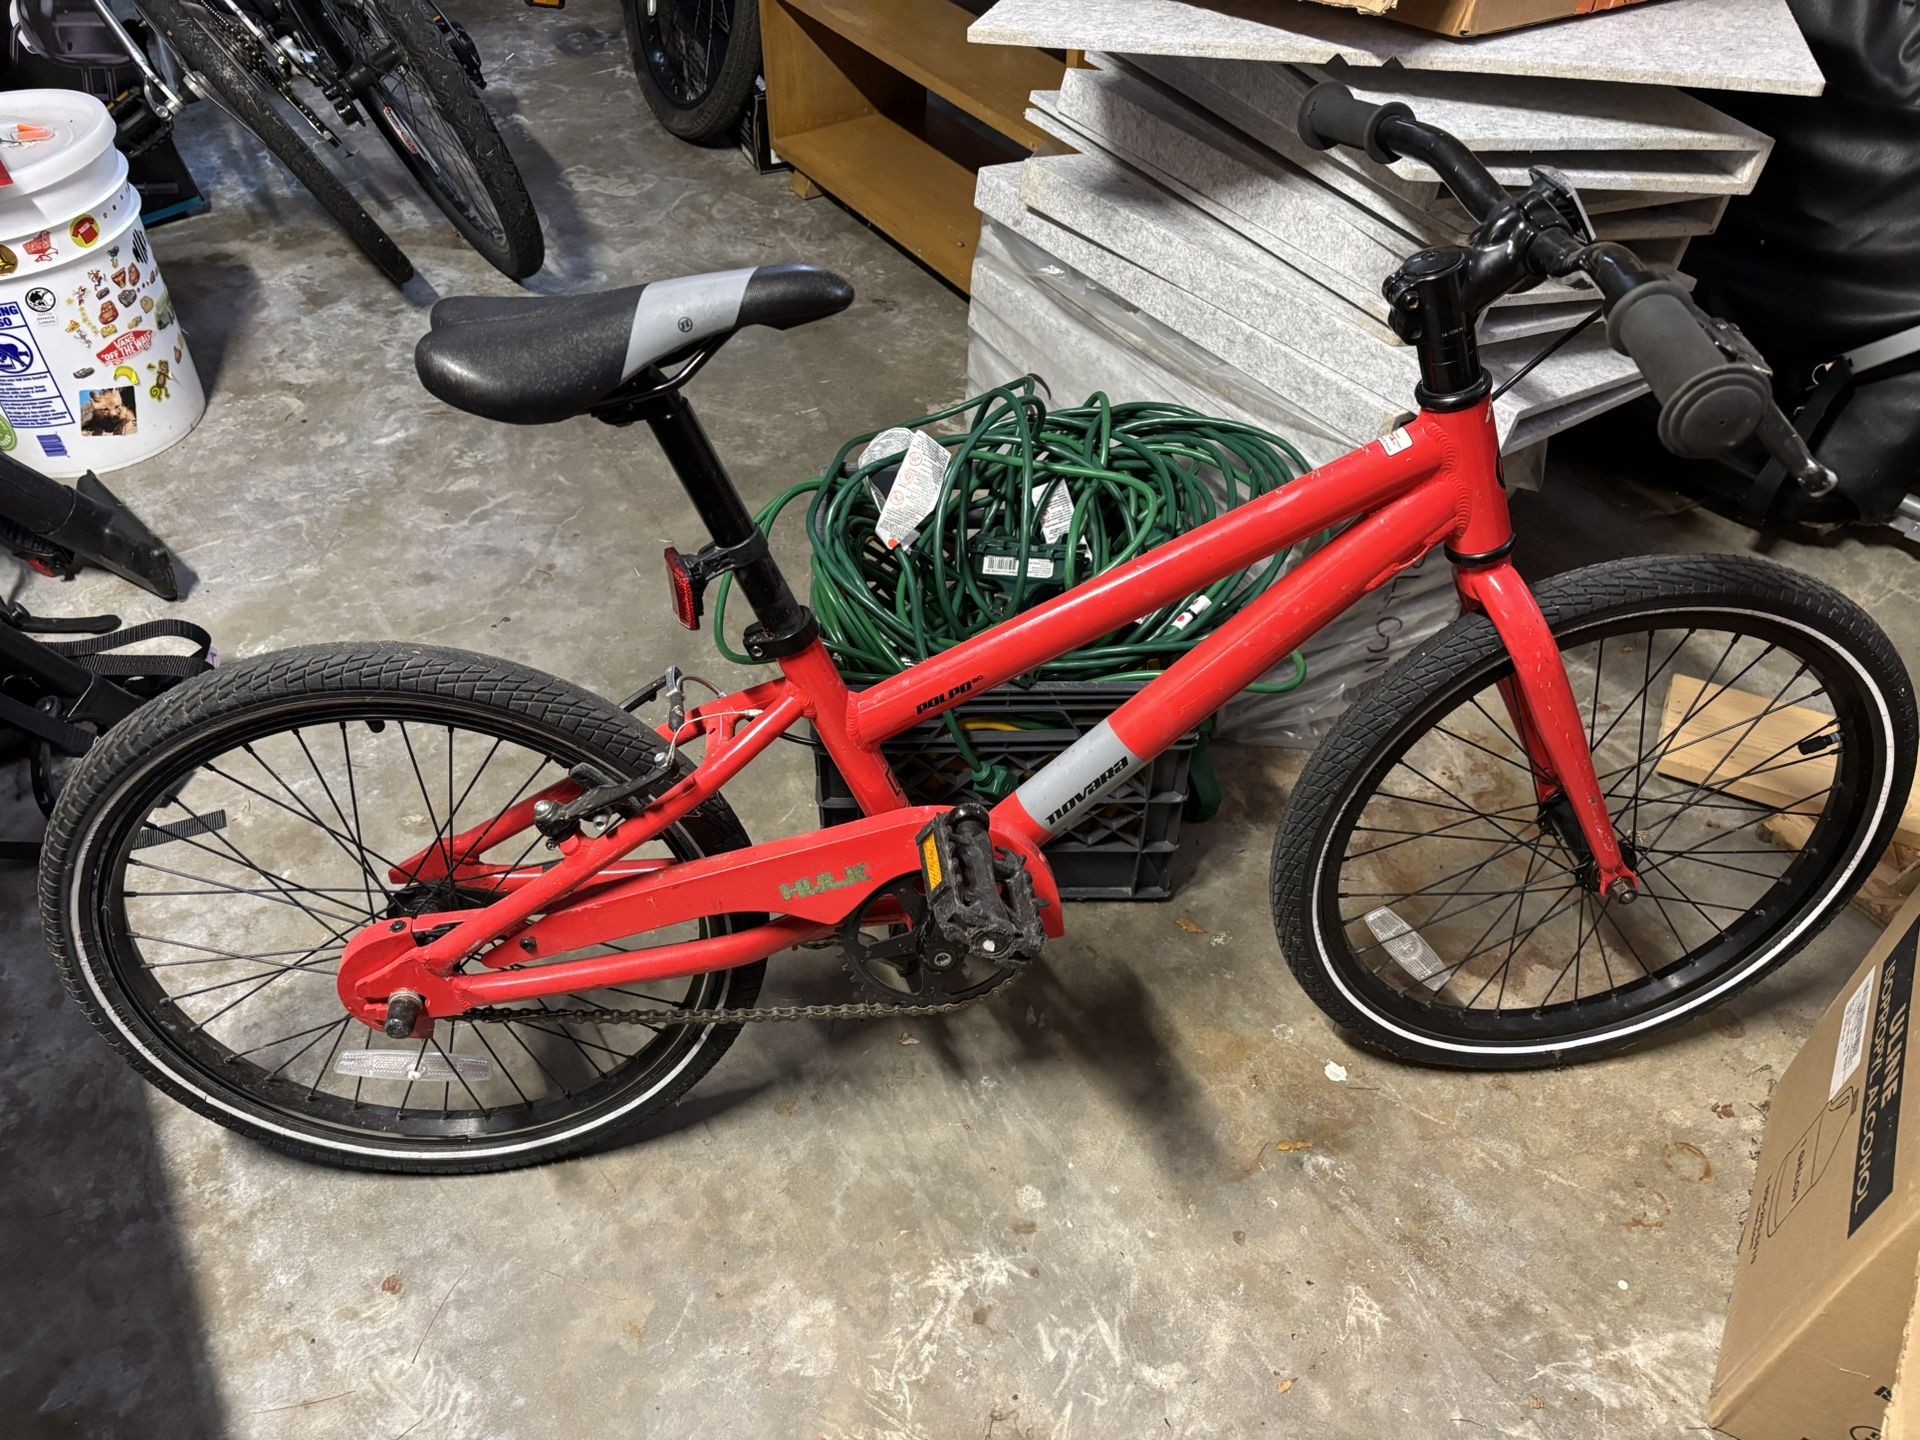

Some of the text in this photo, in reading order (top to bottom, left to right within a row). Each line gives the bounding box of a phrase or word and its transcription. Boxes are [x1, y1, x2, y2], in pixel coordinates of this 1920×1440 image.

[112, 333, 135, 350] VANS
[120, 340, 140, 357] THE
[1871, 960, 1897, 1083] ISOPROPYL
[1881, 1003, 1907, 1109] ULINE
[1855, 1088, 1877, 1213] ALCOHOL
